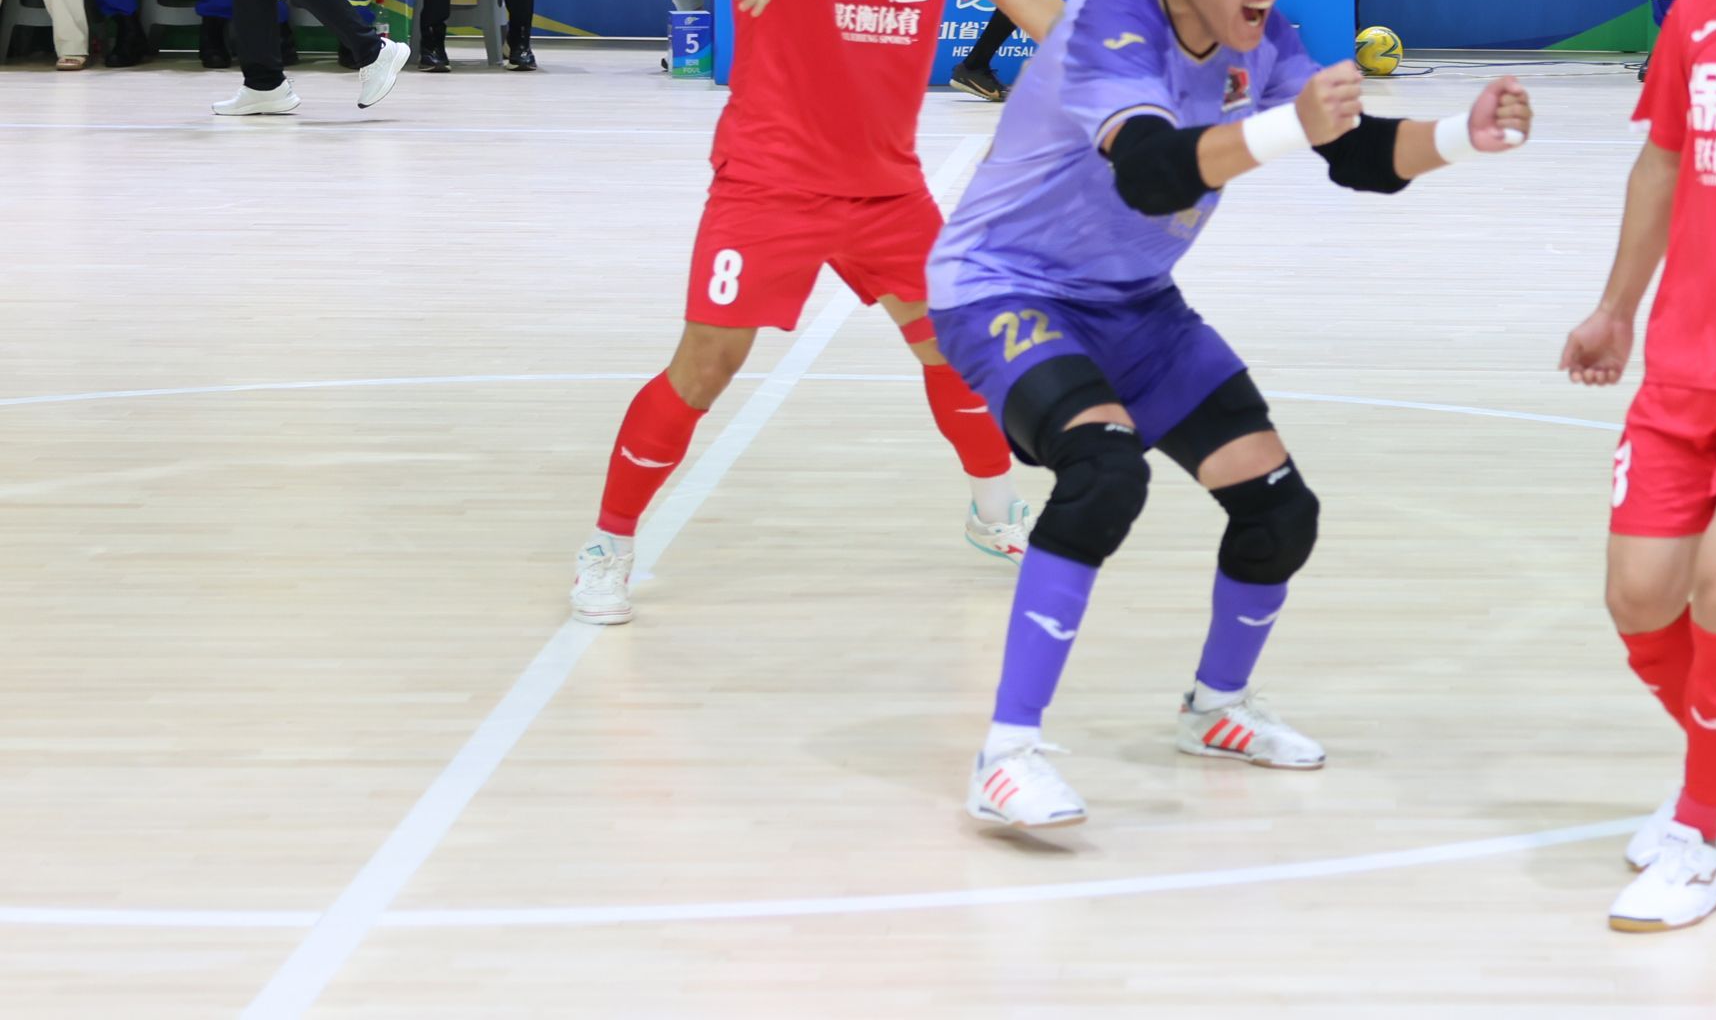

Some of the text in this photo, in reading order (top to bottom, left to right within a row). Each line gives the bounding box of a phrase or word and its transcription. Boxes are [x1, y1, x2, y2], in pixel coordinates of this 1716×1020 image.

[834, 2, 921, 36] 跃衡体育
[685, 33, 700, 54] 5
[708, 249, 743, 306] 8
[989, 308, 1063, 363] 22
